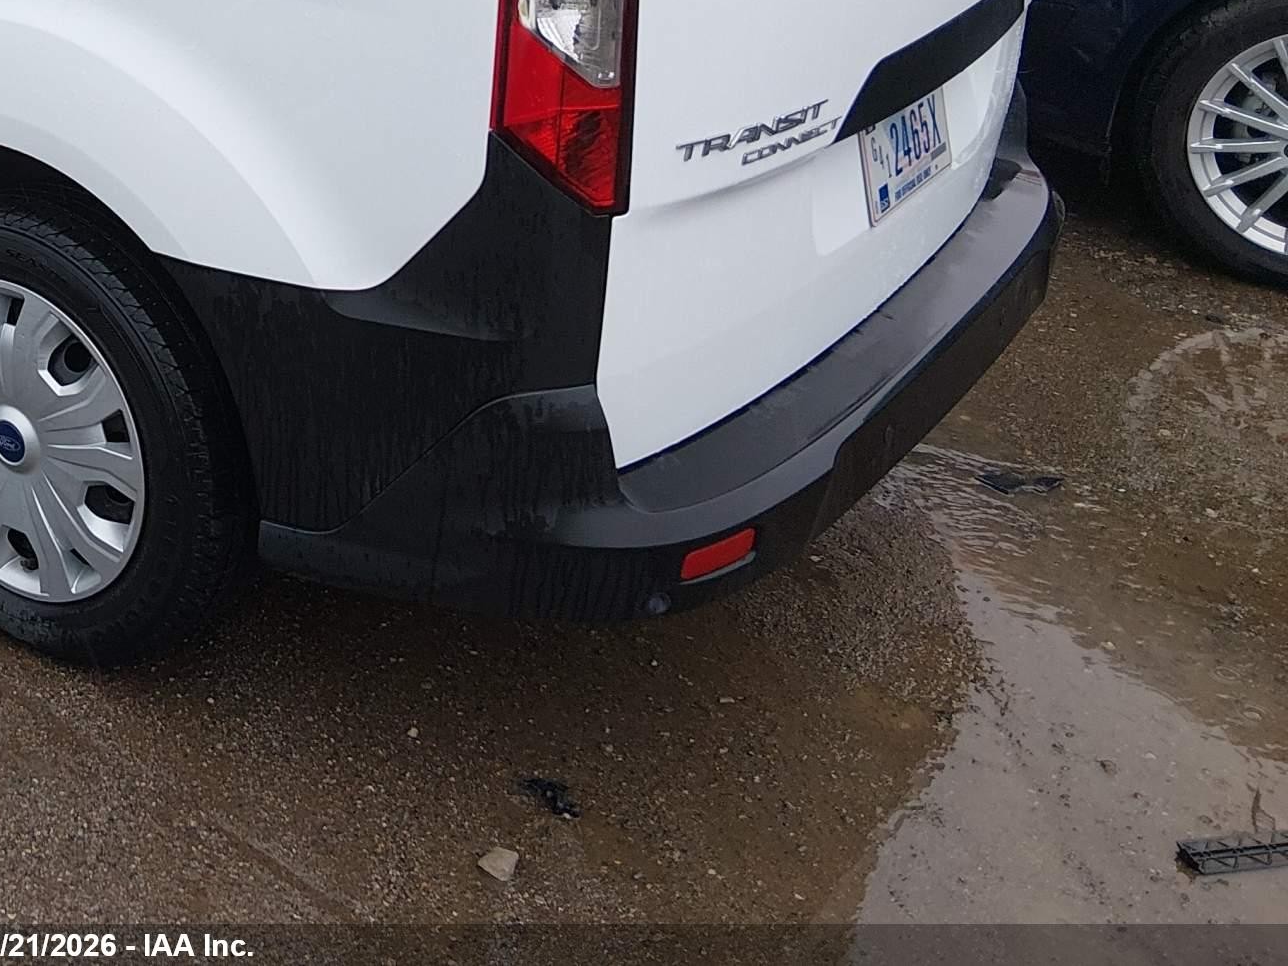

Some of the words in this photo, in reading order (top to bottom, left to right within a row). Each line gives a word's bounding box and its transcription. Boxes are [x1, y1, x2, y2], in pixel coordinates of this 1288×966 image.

[676, 98, 829, 162] TRANSIT
[741, 115, 842, 166] CONNECT
[889, 94, 942, 178] 2465X
